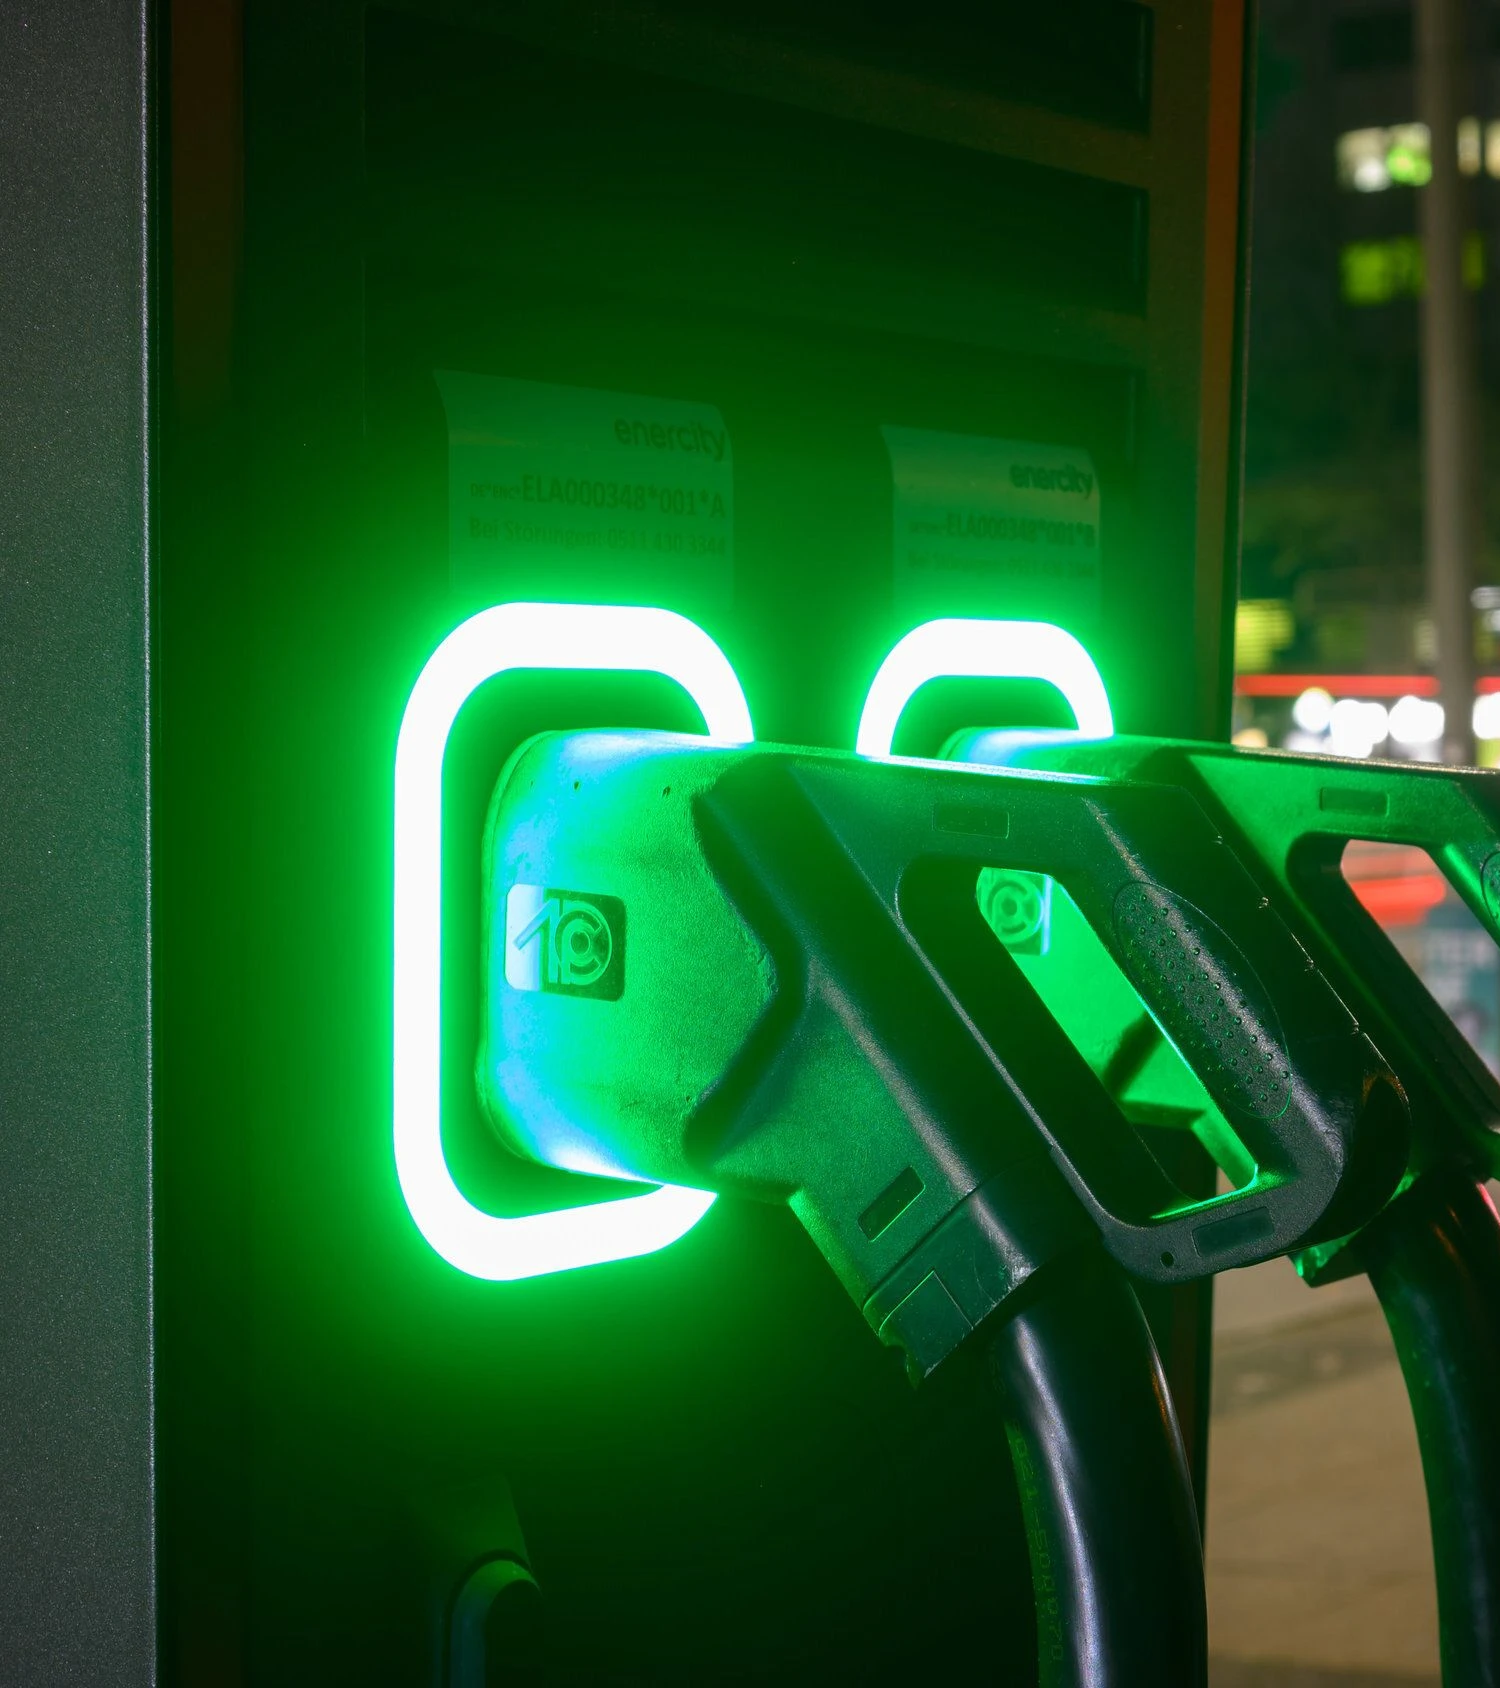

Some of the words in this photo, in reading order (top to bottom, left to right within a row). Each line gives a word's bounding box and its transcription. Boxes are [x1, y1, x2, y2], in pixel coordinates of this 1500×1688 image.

[613, 418, 726, 462] enercity
[1009, 463, 1094, 500] enercity
[469, 516, 498, 541] Bei
